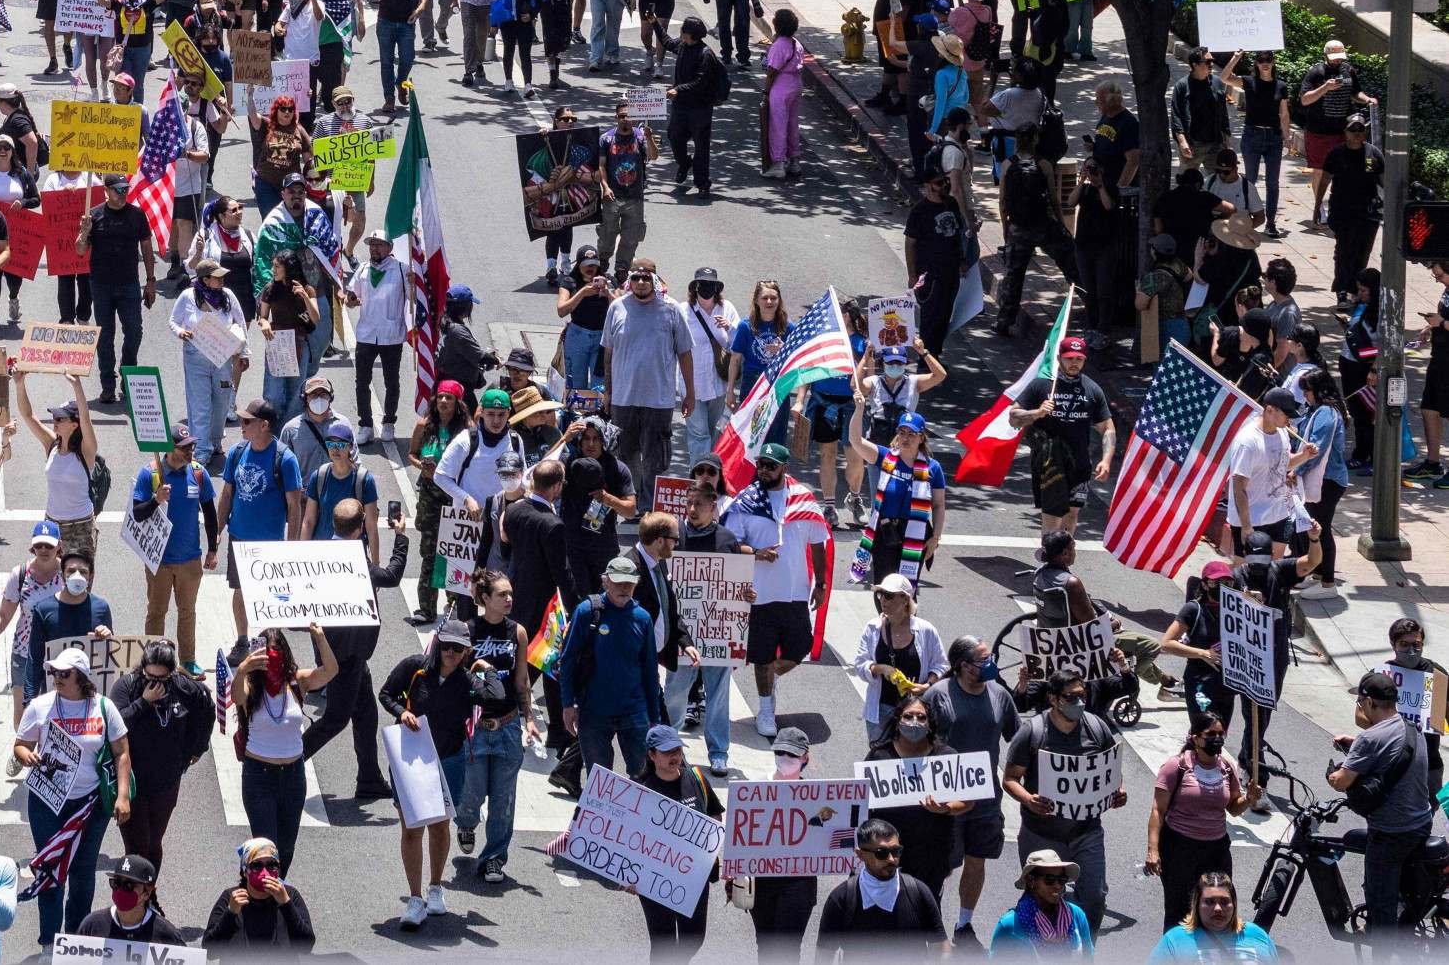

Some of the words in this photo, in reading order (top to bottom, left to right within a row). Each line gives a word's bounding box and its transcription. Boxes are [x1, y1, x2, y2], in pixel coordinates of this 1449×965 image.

[330, 131, 372, 150] STOP
[314, 141, 386, 169] INJUSTICE
[31, 326, 53, 343] NO
[55, 328, 98, 345] KINGS
[443, 506, 457, 516] LA
[250, 559, 355, 582] CONSTITUTION
[672, 556, 725, 582] PARA
[268, 581, 294, 596] not
[253, 599, 379, 623] RECOMMENDATION!
[1222, 591, 1244, 615] ICE
[1244, 602, 1271, 629] OUT
[1029, 619, 1104, 656] ISANG
[1223, 614, 1244, 639] OF
[1245, 623, 1267, 651] LA!
[1228, 641, 1247, 661] END
[1248, 650, 1263, 667] THE
[1229, 656, 1267, 687] VIOLENT
[1050, 747, 1118, 773] UNITY
[737, 784, 779, 802] CAN
[788, 784, 820, 802] YOU
[826, 783, 867, 802] EVEN
[864, 761, 925, 799] Abolish
[1056, 769, 1112, 795] OVER
[590, 770, 643, 816] NAZI
[650, 798, 726, 854] SOLDIERS
[732, 808, 808, 847] READ
[577, 808, 695, 874] FOLLOWING
[567, 840, 644, 886] ORDERS
[649, 869, 687, 906] TOO
[722, 858, 747, 877] THE
[55, 937, 113, 959] Somos
